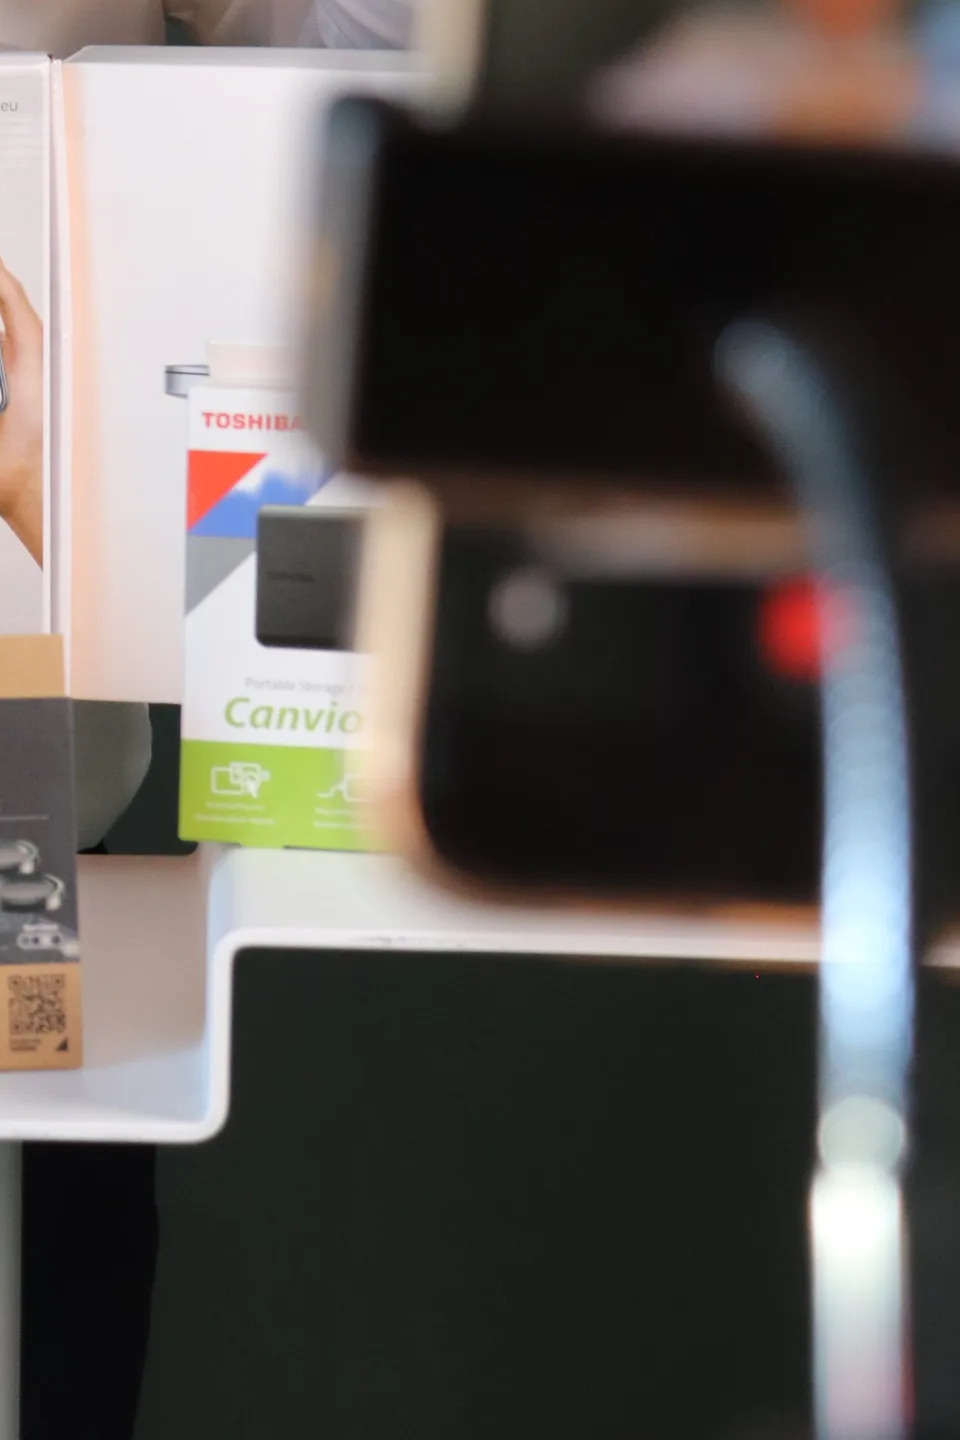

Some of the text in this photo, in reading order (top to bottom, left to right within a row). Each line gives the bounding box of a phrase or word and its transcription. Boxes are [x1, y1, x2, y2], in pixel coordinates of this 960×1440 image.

[201, 412, 304, 431] TOSHIBA
[244, 676, 296, 691] Portable
[223, 695, 364, 734] Canvio
